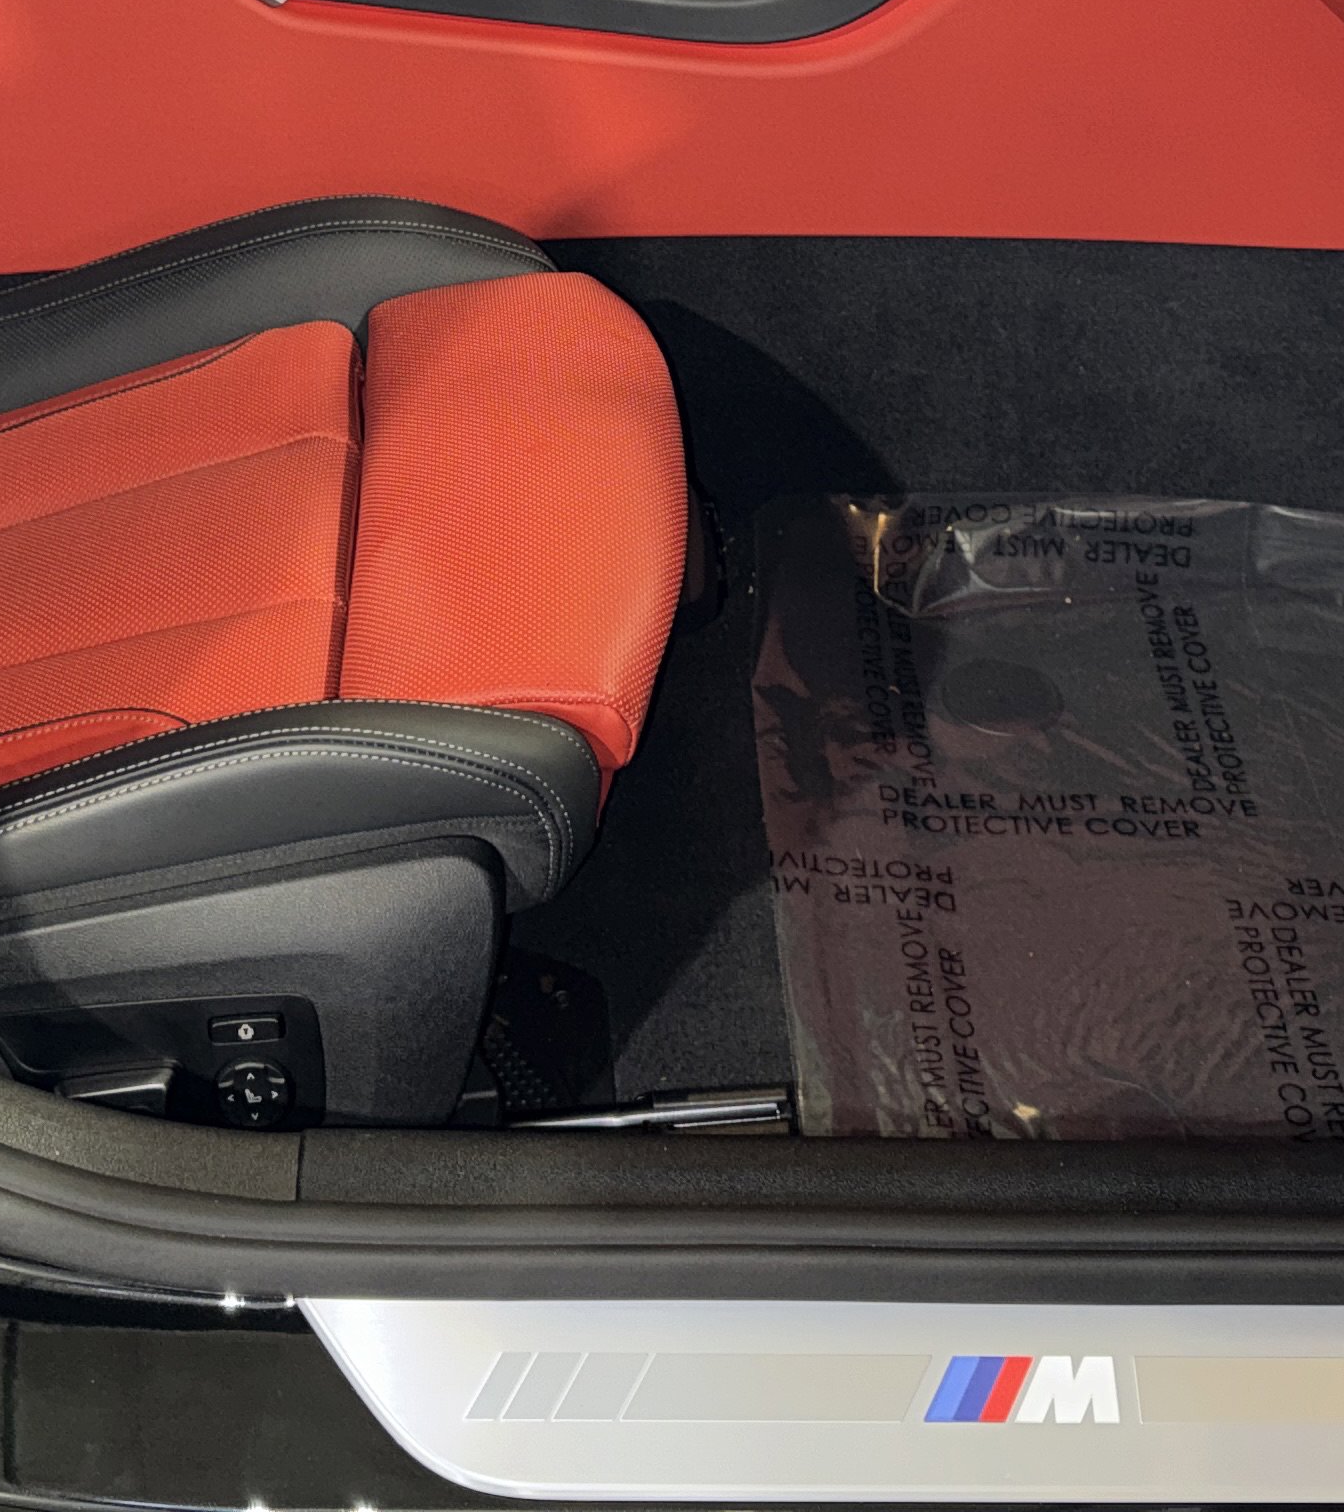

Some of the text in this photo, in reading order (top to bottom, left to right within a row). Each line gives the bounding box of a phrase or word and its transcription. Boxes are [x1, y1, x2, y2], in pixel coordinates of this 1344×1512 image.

[915, 503, 1012, 528] COVER
[993, 534, 1065, 560] MUST
[1085, 539, 1192, 569] DEALER
[1135, 569, 1217, 792] DEALER MUST REMOVE
[1172, 604, 1251, 795] PROTECTIVE COVER
[878, 784, 1259, 818] DEALER MUST REMOVE
[882, 808, 1203, 838] PROTECTIVE COVER
[834, 883, 957, 913] DEALER
[896, 908, 937, 1014] REMOVE
[938, 946, 976, 1040] COVER
[1233, 925, 1300, 1076] PROTECTIVE
[1269, 927, 1321, 1017] DEALER
[1299, 1025, 1344, 1094] MUST
[912, 1021, 945, 1089] MUST
[1014, 1355, 1121, 1424] M
